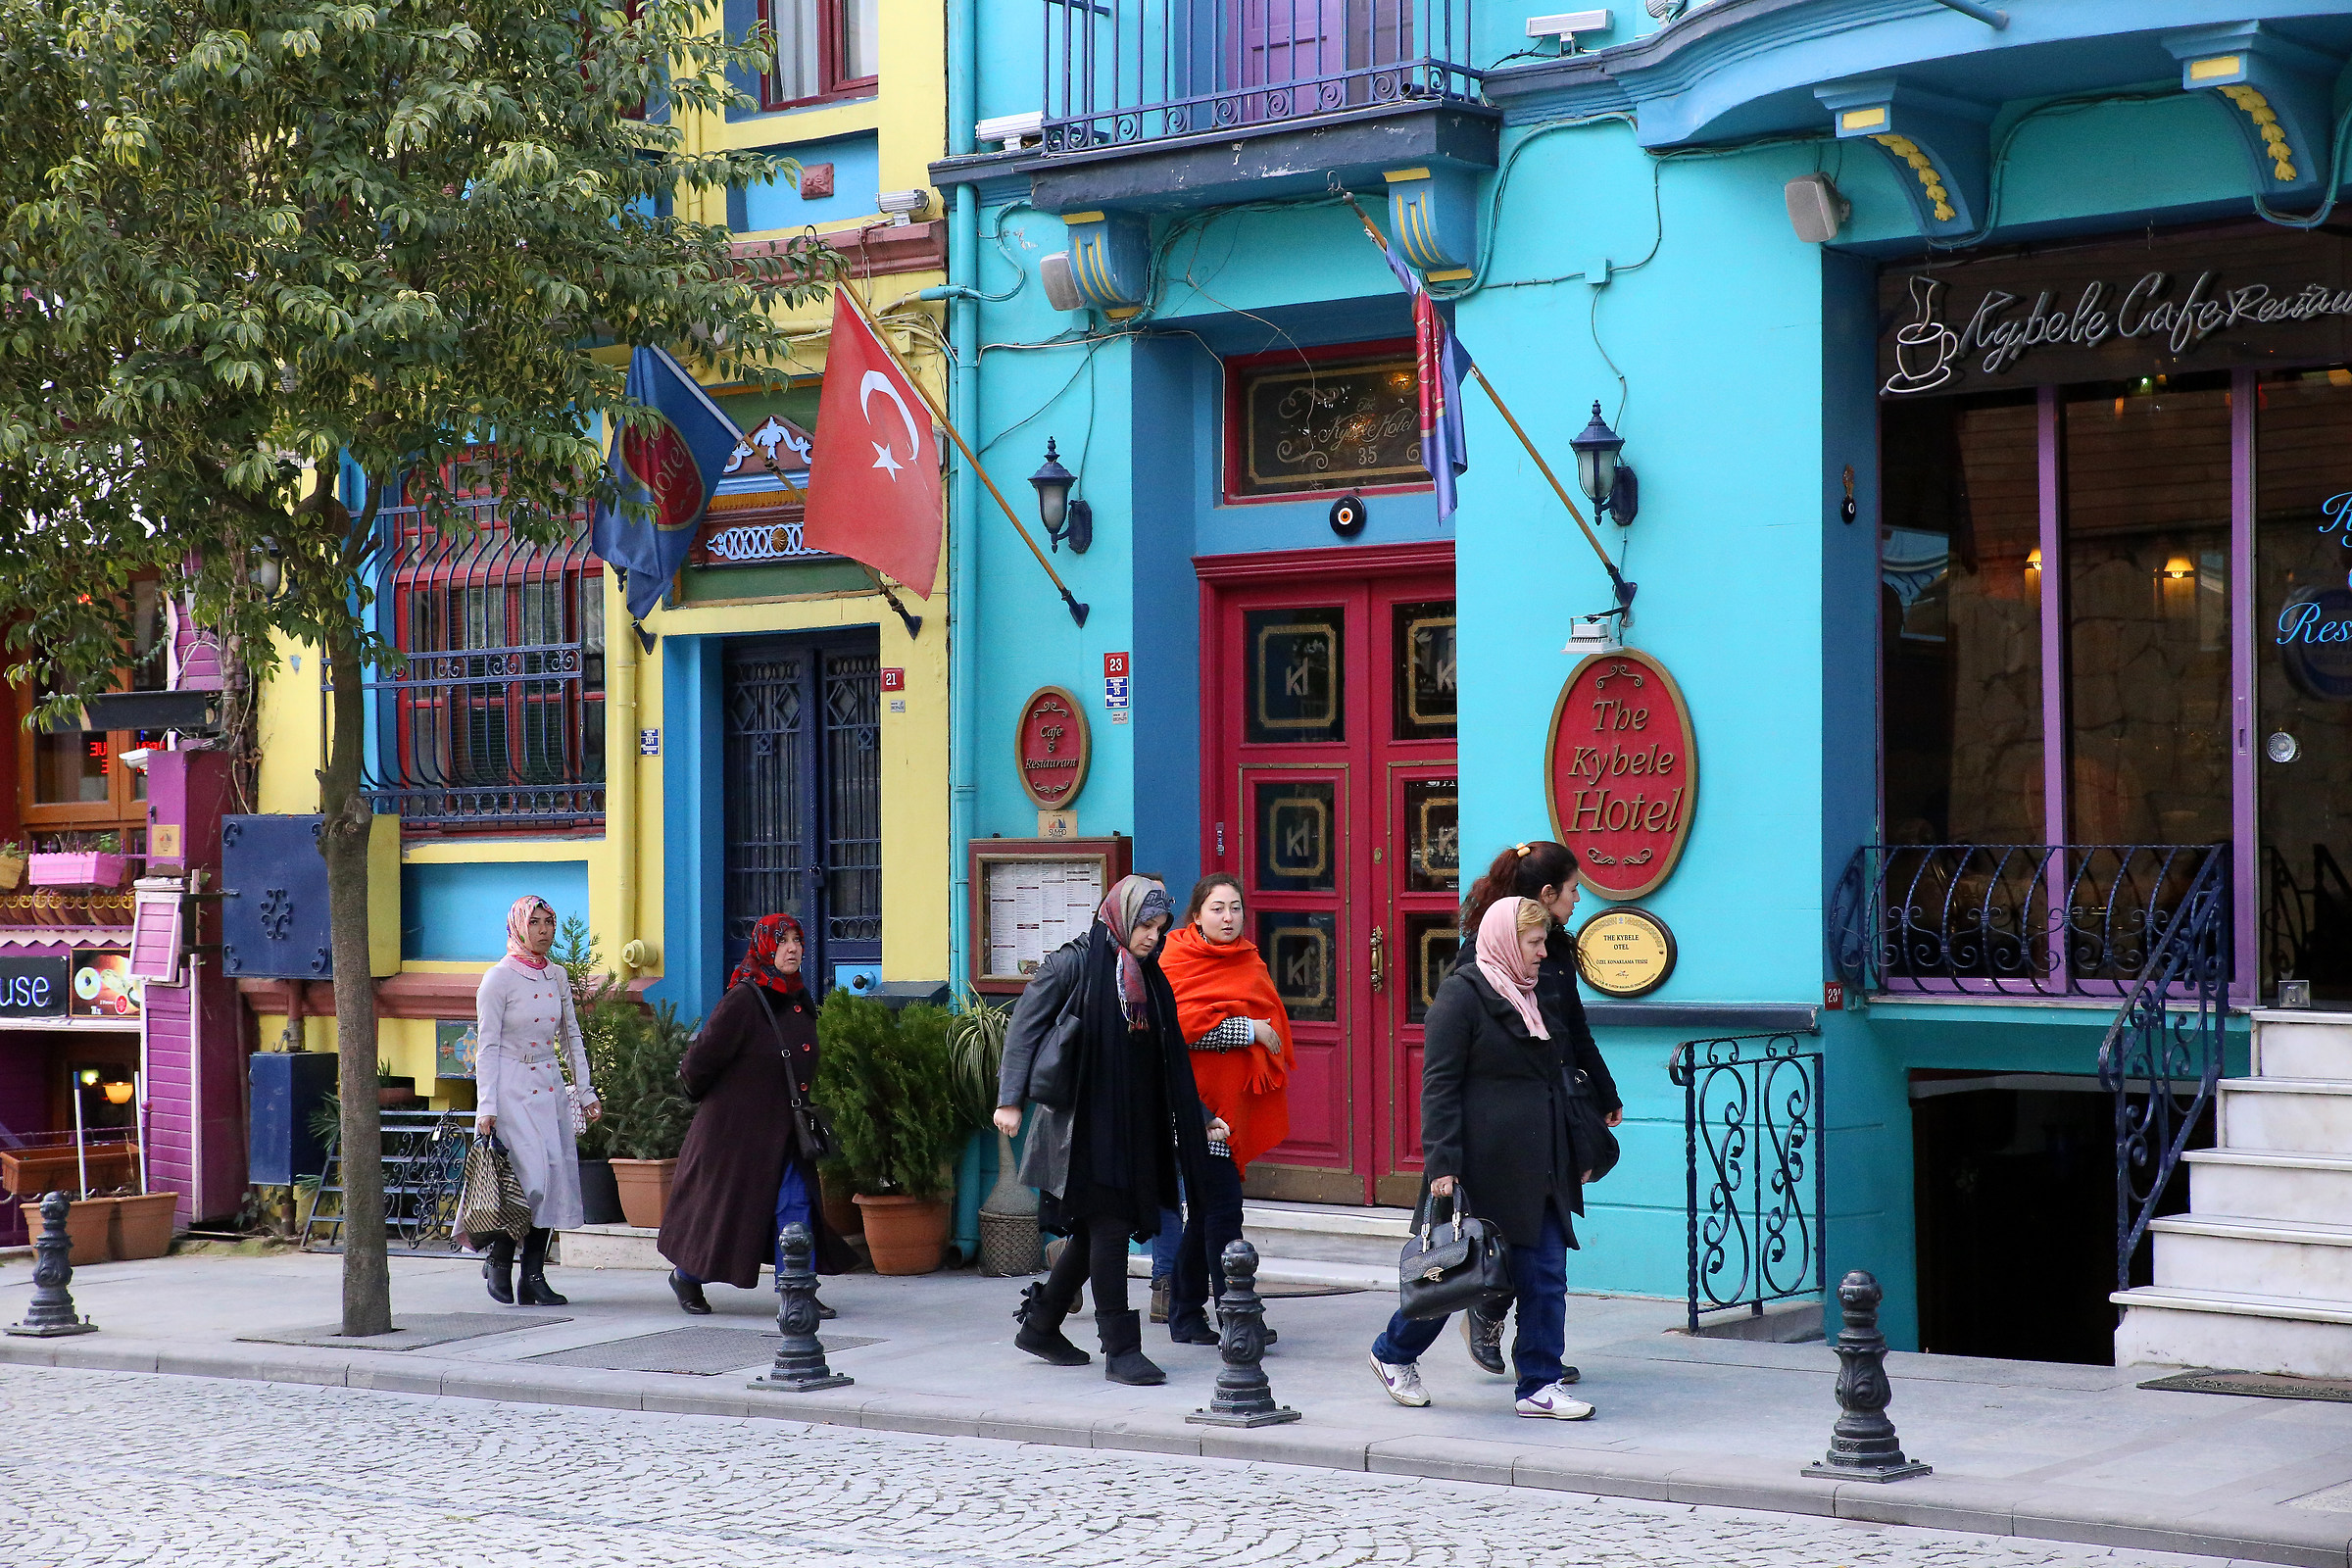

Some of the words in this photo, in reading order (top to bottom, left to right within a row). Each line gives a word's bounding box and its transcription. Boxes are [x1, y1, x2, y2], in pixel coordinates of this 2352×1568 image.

[1962, 280, 2109, 373] Kybele
[2118, 270, 2221, 353] Cafe
[1358, 446, 1378, 466] 35
[1109, 658, 1123, 671] 23
[885, 672, 898, 686] 21
[1592, 699, 1649, 731] The
[1048, 742, 1055, 753] &
[1025, 758, 1079, 769] Restaurant
[1568, 743, 1675, 786] Kybele
[1566, 787, 1684, 833] Hotel
